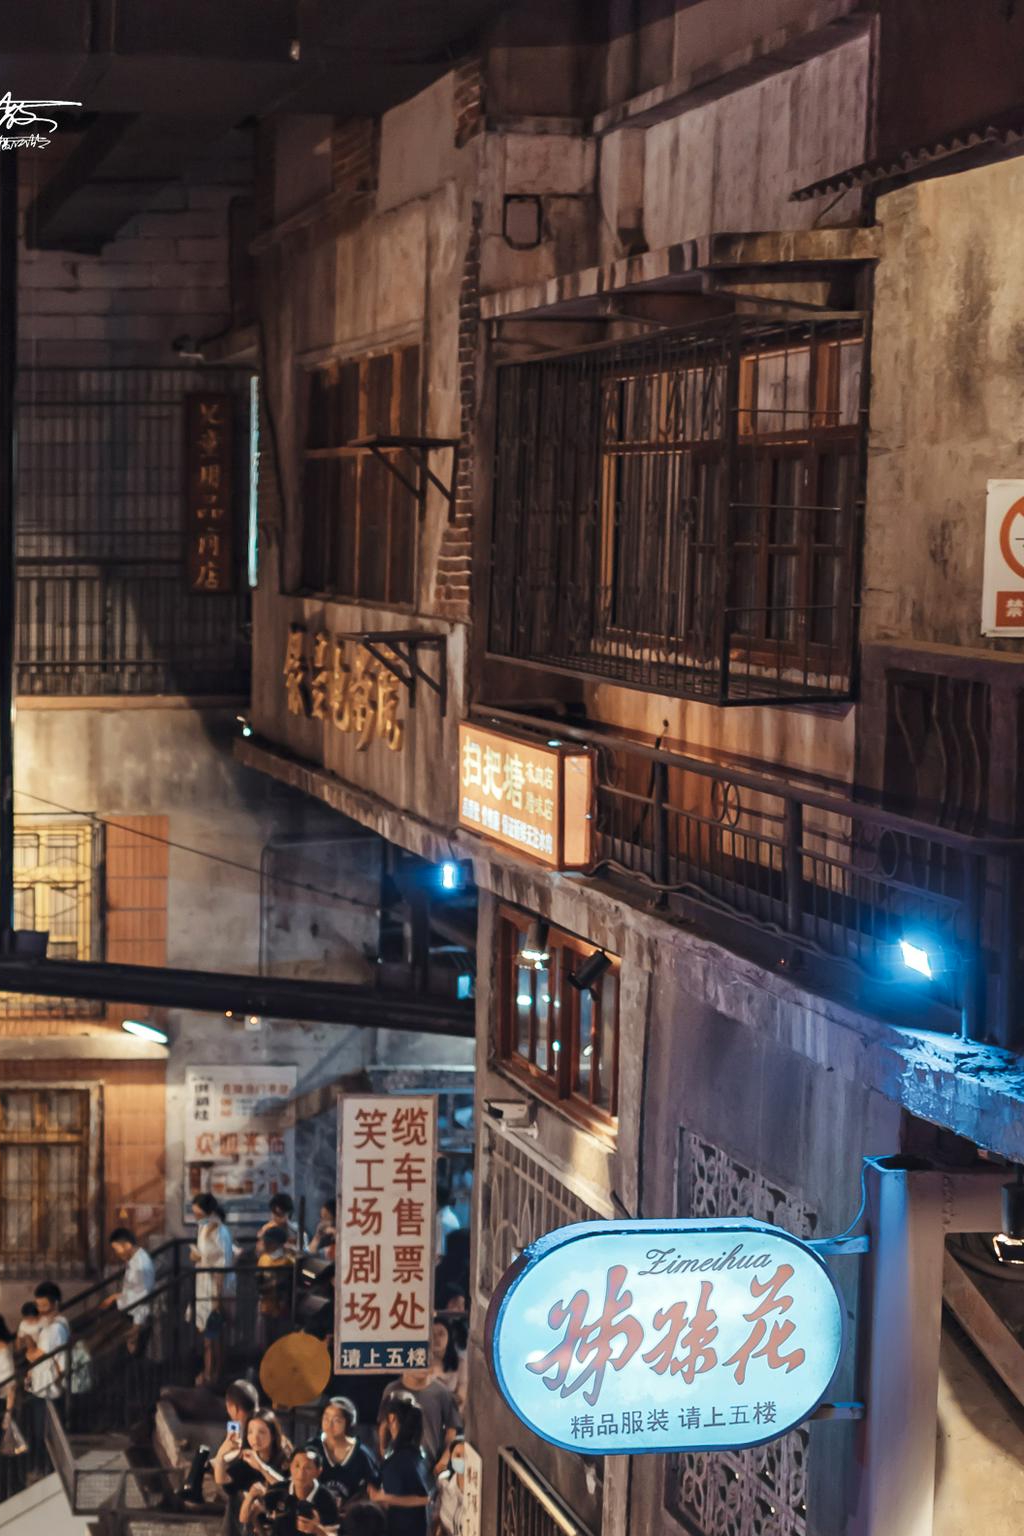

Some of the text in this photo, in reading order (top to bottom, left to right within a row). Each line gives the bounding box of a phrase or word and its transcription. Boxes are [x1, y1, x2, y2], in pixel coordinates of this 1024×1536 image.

[343, 1108, 387, 1332] 笑工场剧场
[388, 1107, 429, 1332] 缆车售票处
[637, 1243, 773, 1277] Zimeihua
[342, 1347, 426, 1369] 请上五楼
[570, 1401, 777, 1440] 精品服装 请上五楼
